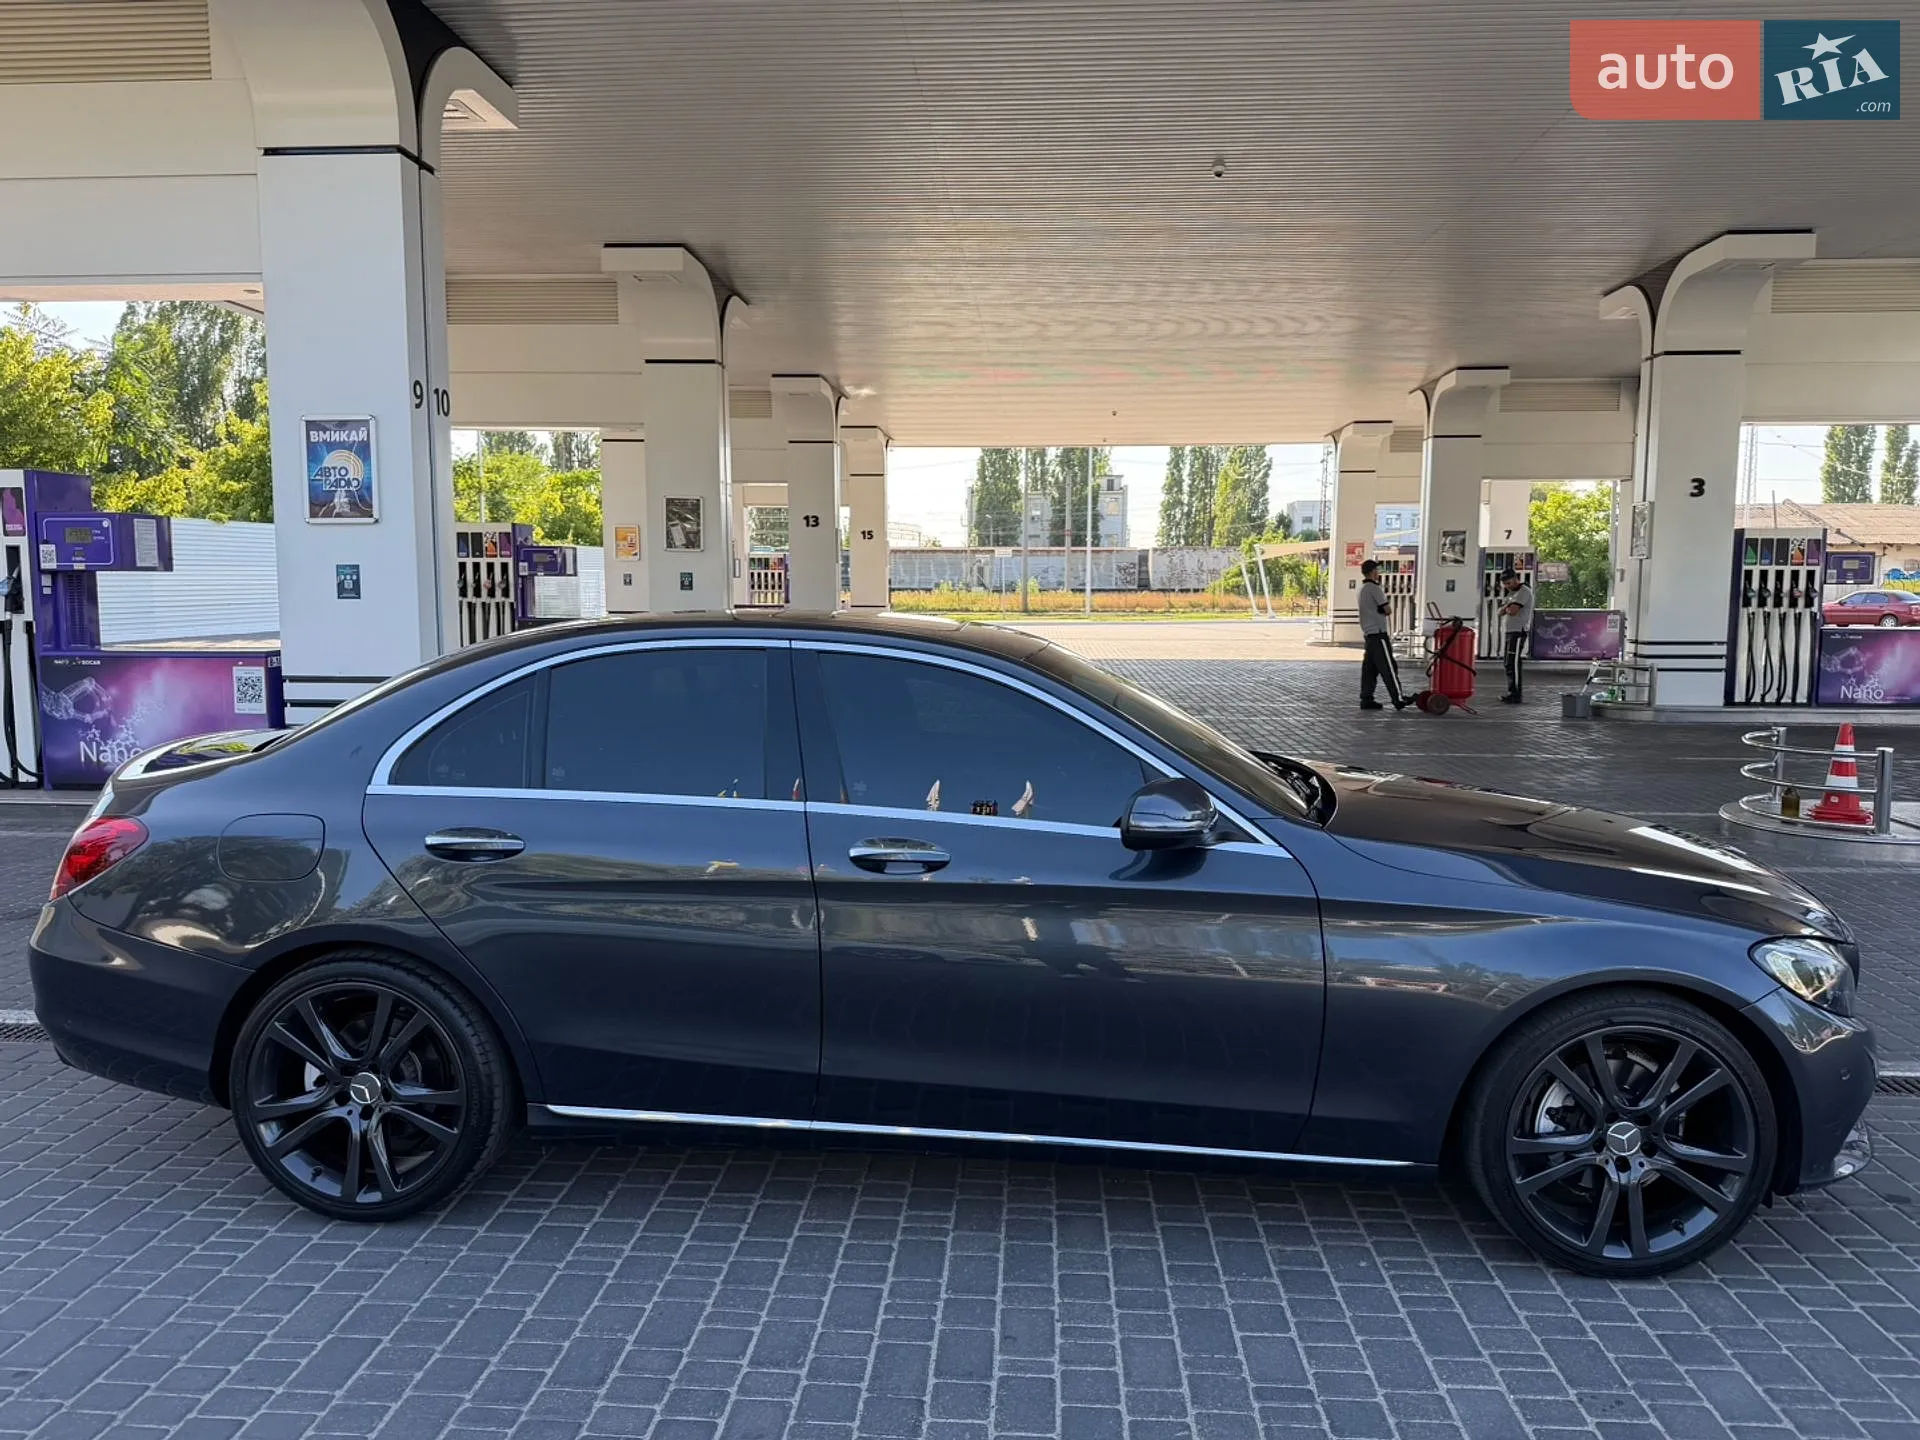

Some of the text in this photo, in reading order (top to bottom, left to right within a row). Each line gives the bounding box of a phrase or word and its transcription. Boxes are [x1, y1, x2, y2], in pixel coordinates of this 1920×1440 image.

[413, 379, 424, 409] 9
[433, 387, 450, 417] 10
[309, 427, 368, 443] ВМИКАЙ
[313, 466, 349, 478] АВТО
[1689, 477, 1706, 498] 3
[803, 515, 820, 528] 13
[861, 529, 874, 541] 15
[1504, 529, 1513, 540] 7
[1840, 685, 1884, 700] Nano
